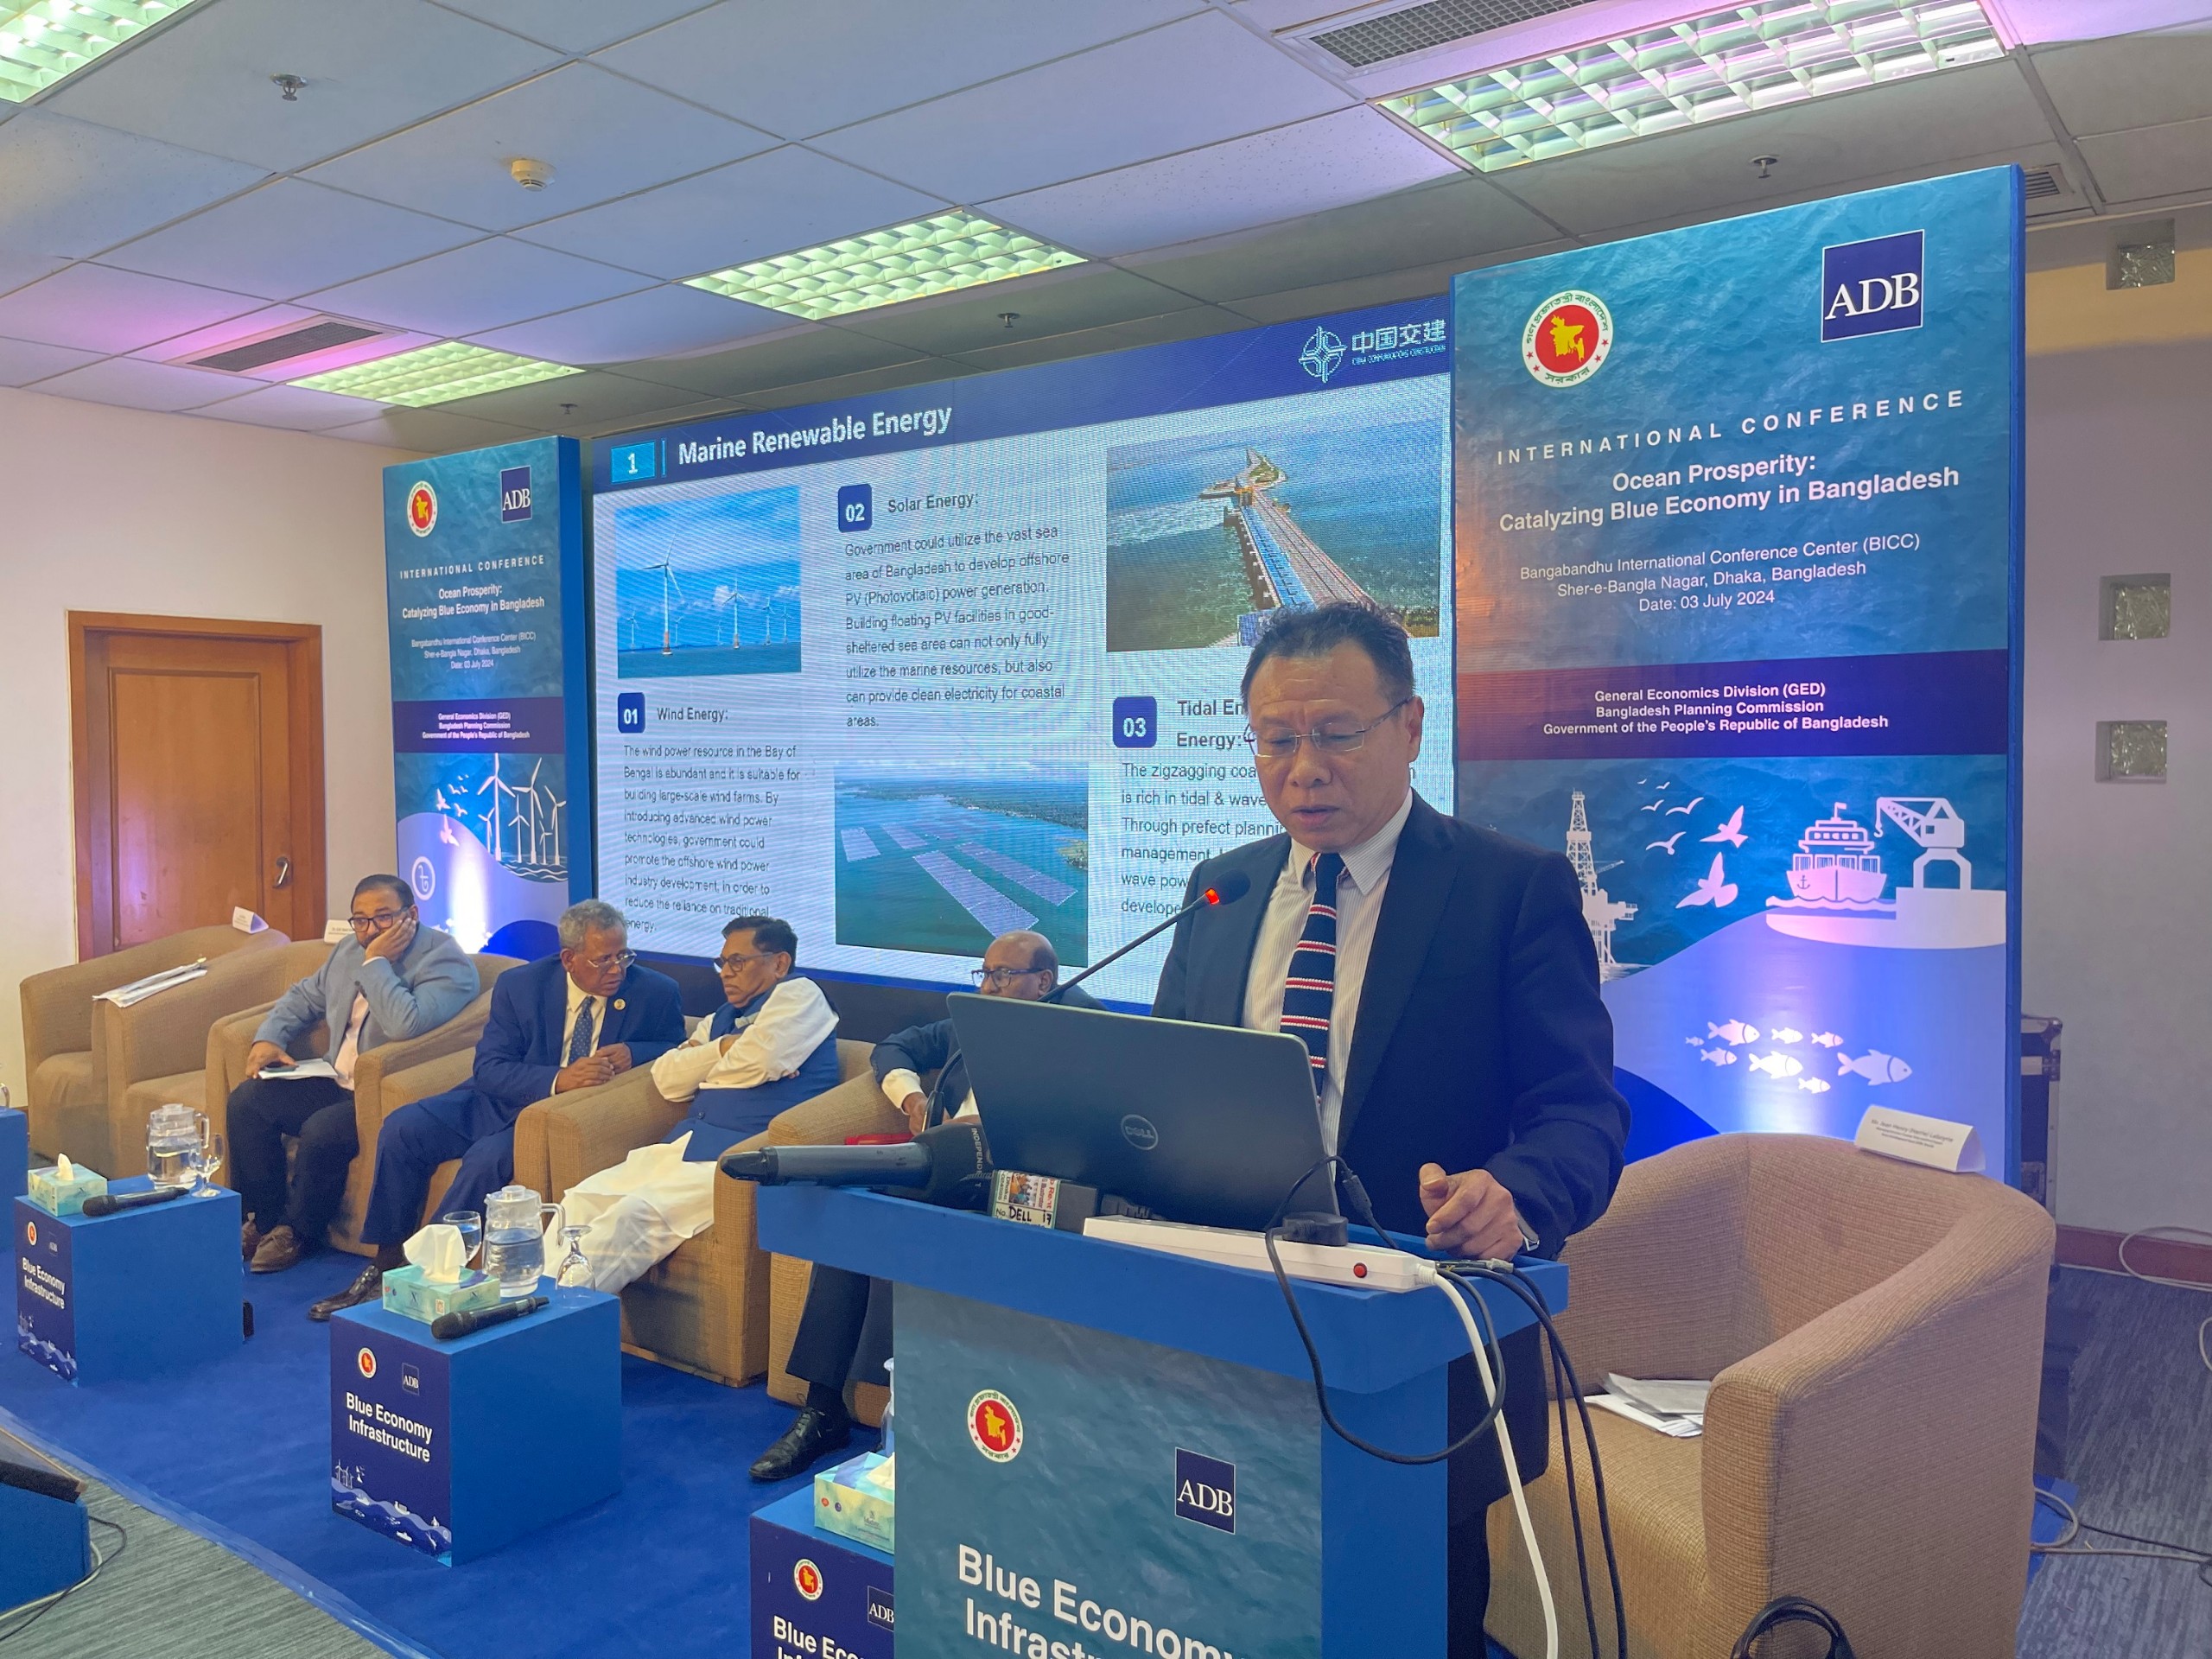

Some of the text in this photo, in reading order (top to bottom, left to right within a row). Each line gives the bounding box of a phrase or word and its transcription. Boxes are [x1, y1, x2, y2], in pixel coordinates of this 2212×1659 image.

[1824, 272, 1920, 321] ADB
[1351, 319, 1446, 353] 中国交建
[678, 407, 952, 465] Marine Renewable Energy
[1497, 390, 1963, 465] INTERNATIONAL CONFERENCE
[627, 453, 638, 474] 1
[1612, 454, 1816, 491] Ocean Prosperity:
[502, 488, 531, 512] ADB
[888, 493, 978, 512] Solar Energy:
[1499, 467, 1959, 531] Catalyzing Blue Economy in Bangladesh
[846, 504, 865, 523] 02
[845, 527, 1058, 556] Government could utilize the vast sea
[400, 555, 544, 580] INTERNATIONAL CONFERENCE
[845, 552, 1069, 581] area of Bangladesh to develop offshore
[1520, 533, 1920, 580] Bangabandhu International Conference Center (BICC)
[1557, 561, 1866, 598] Sher-e-Bangla Nagar, Dhaka, Bangladesh
[439, 584, 502, 600] Ocean Prosperity:
[845, 580, 1049, 607] PV (Photovoltaic) power generation.
[1639, 590, 1775, 612] Date: 03 July 2024
[402, 596, 544, 620] Catalyzing Blue Economy in Bangladesh
[846, 605, 1054, 631] Building floating PV facilities in good-
[846, 632, 1049, 654] sheltered sea area can not only fully
[846, 659, 1053, 678] utilize the marine resources, but also
[846, 683, 1065, 705] can provide clean electricity for coastal
[1595, 682, 1826, 702] General Economics Division (GED)
[624, 709, 639, 724] 01
[657, 707, 728, 722] Wind Energy:
[1178, 700, 1217, 716] Tidal
[1596, 699, 1824, 719] Bangladesh Planning Commission
[847, 715, 879, 727] areas.
[1123, 717, 1147, 738] 03
[1543, 722, 1618, 735] Government
[1621, 721, 1634, 734] of
[1637, 721, 1657, 734] the
[1719, 717, 1781, 733] Republic
[1783, 716, 1799, 730] of
[1802, 715, 1889, 733] Bangladesh
[624, 745, 797, 760] The wind power resource in the Bay of
[1177, 733, 1242, 750] Energy:
[1122, 763, 1147, 778] The
[1152, 763, 1225, 780] zigzagging
[1122, 790, 1132, 804] is
[1136, 790, 1160, 804] rich
[1165, 791, 1176, 804] in
[1180, 791, 1209, 805] tidal
[1214, 791, 1224, 805] &
[1122, 817, 1177, 836] Through
[1182, 820, 1230, 836] prefect
[1122, 874, 1188, 891] wave pow
[1008, 1205, 1032, 1222] DELL
[22, 1257, 65, 1295] Blue Economy
[24, 1274, 65, 1309] Infrastructure
[404, 1375, 419, 1389] ADB
[346, 1392, 432, 1445] Blue Economy
[349, 1414, 430, 1462] Infrastructure
[1177, 1478, 1234, 1517] ADB
[959, 1544, 1246, 1659] Blue Econom
[869, 1602, 894, 1624] ADB
[773, 1615, 817, 1653] Blue
